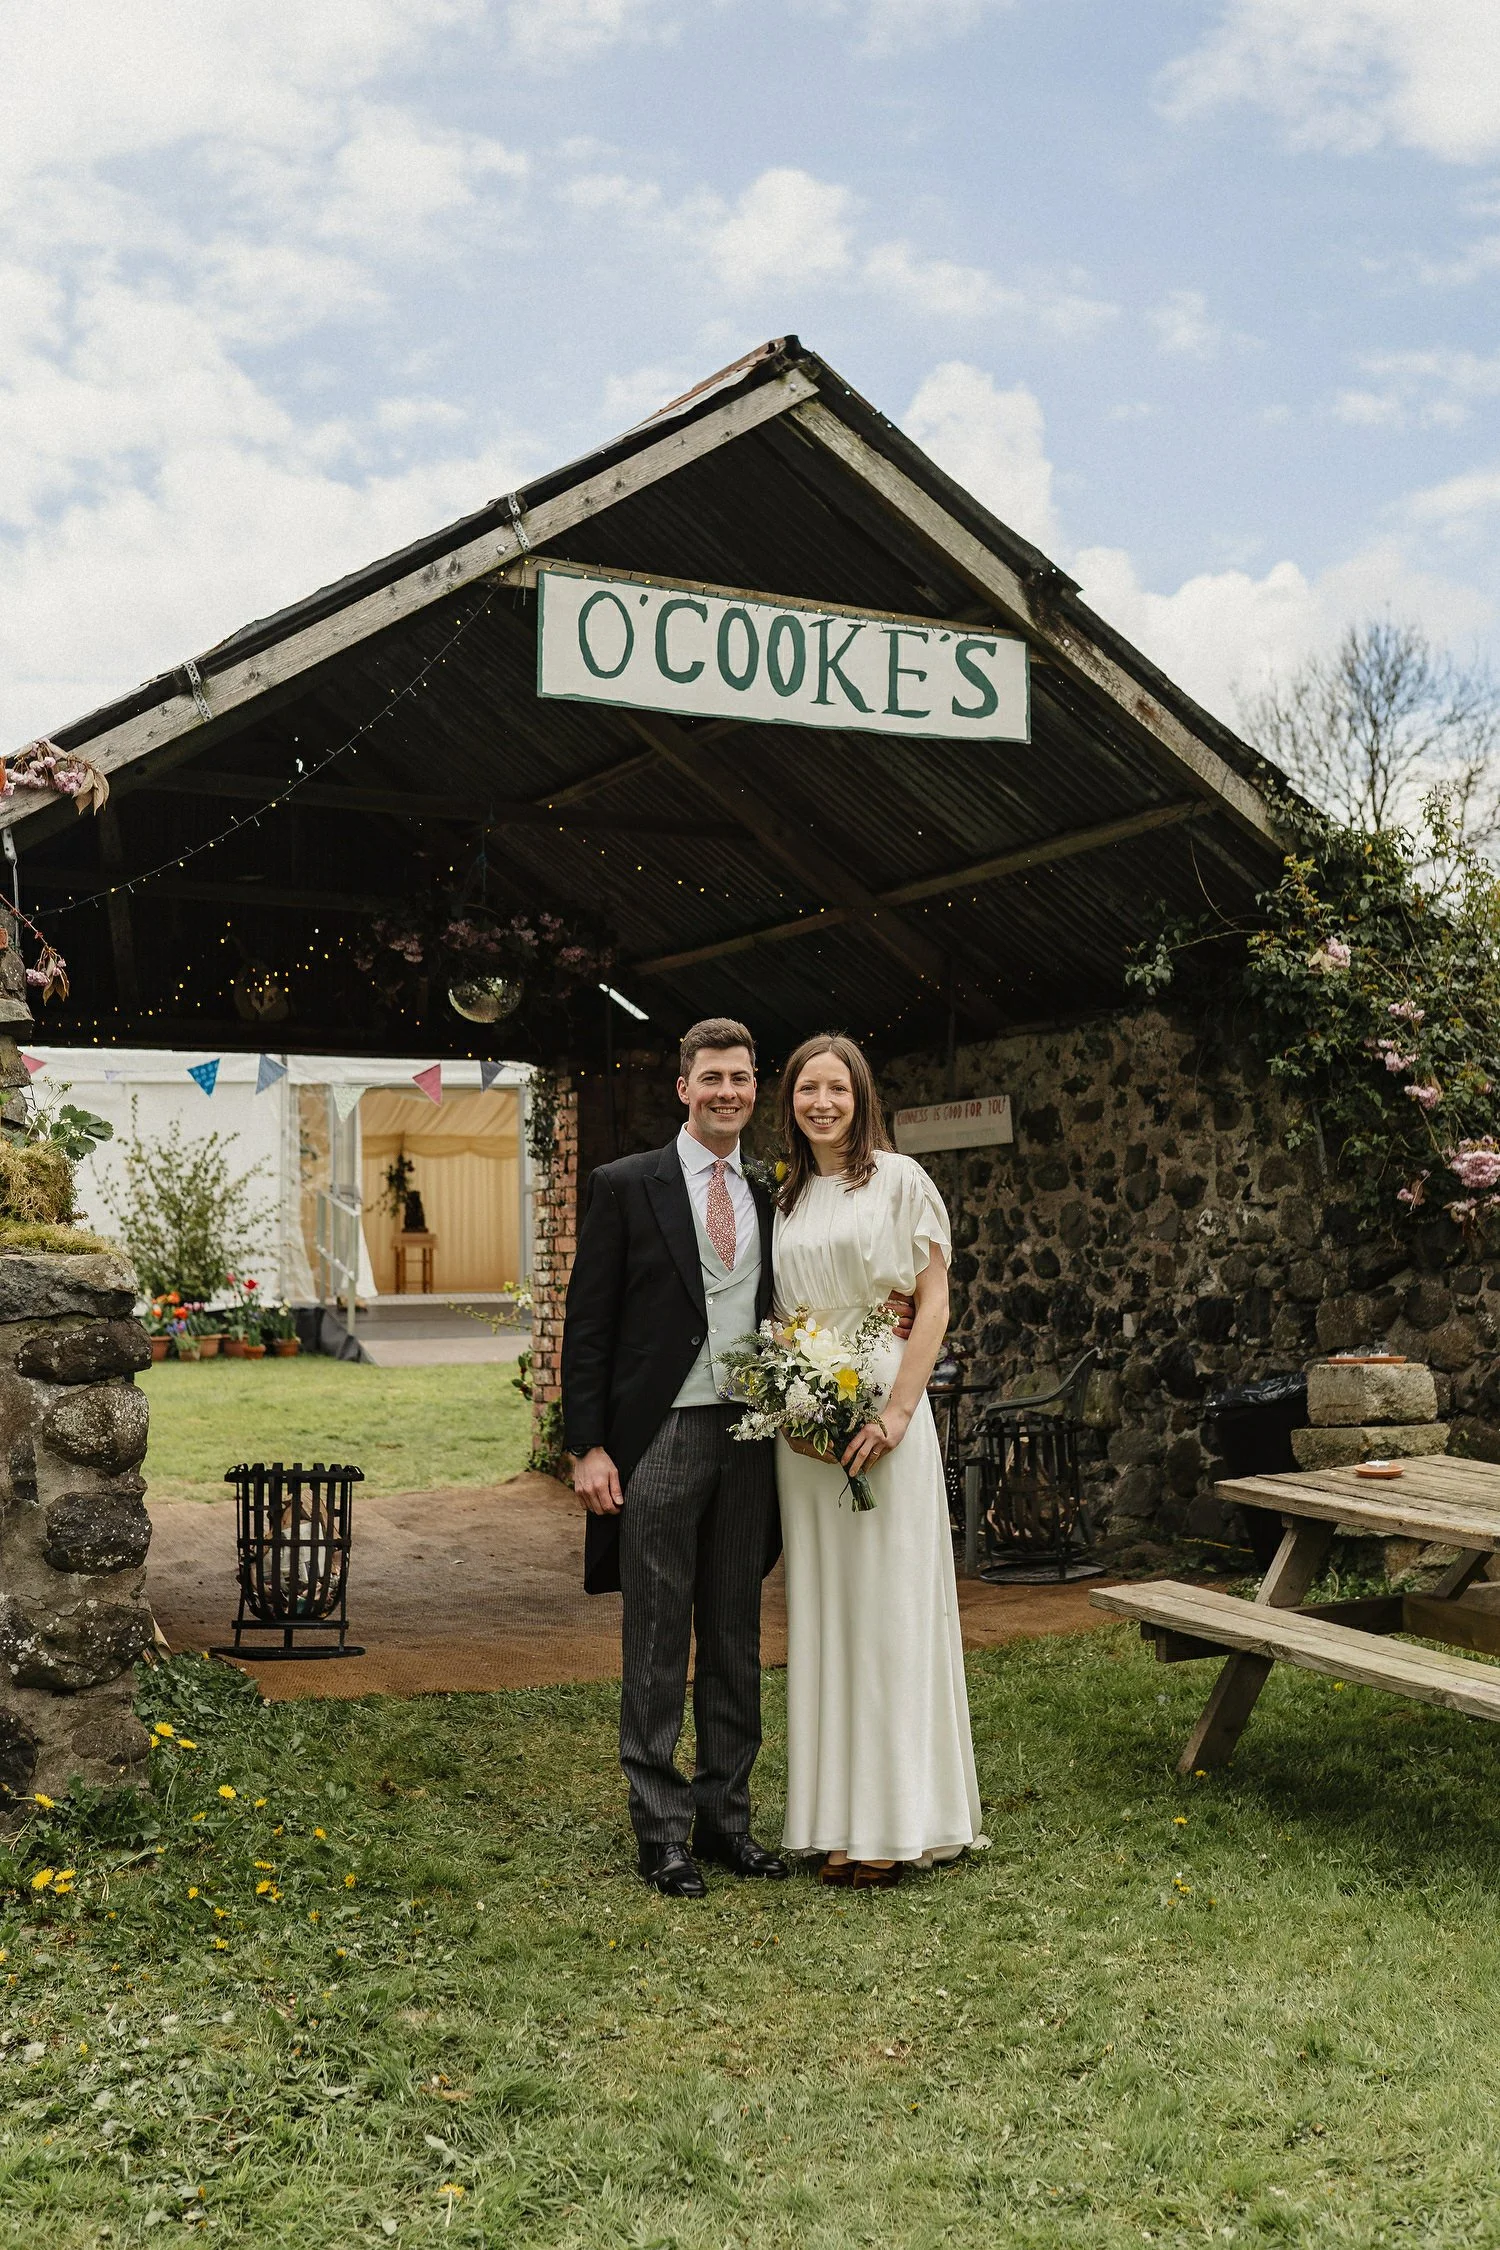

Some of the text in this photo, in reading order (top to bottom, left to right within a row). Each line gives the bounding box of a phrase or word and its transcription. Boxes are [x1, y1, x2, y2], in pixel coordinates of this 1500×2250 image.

[578, 590, 999, 718] O'COOKE'S
[933, 1106, 940, 1121] IS
[943, 1104, 962, 1120] GOOD
[965, 1101, 982, 1118] FOR
